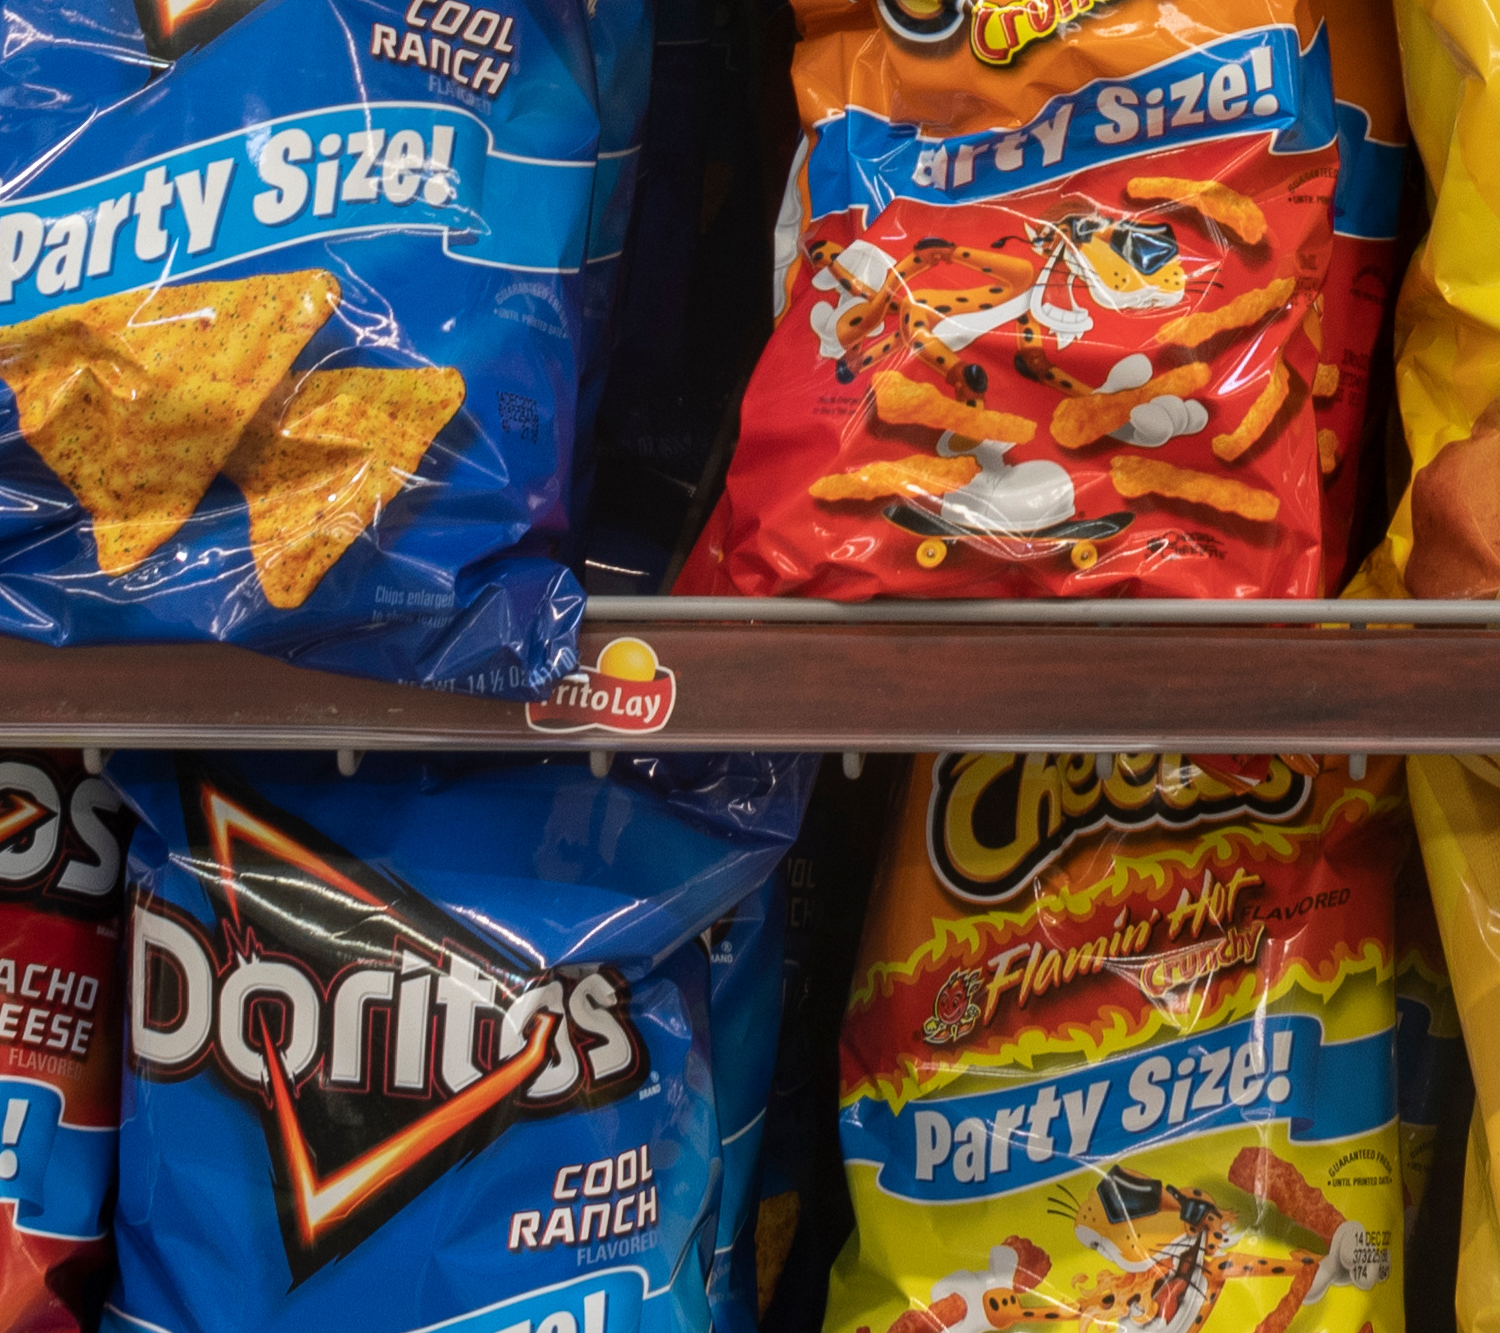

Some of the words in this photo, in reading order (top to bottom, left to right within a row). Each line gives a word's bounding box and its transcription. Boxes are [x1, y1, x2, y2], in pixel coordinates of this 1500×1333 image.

[373, 24, 513, 97] RANCH
[1095, 47, 1279, 144] Size!
[375, 585, 404, 605] Chips
[407, 587, 455, 607] enlarged
[133, 904, 632, 1098] Doritos
[915, 1082, 1111, 1183] Party
[1122, 1032, 1293, 1133] Size!
[553, 1144, 652, 1200] COOL
[1329, 1149, 1375, 1177] GUARANTEED
[1375, 1152, 1393, 1175] FRESH
[1332, 1177, 1351, 1188] UNTIL
[1353, 1176, 1377, 1187] PRINTED
[509, 1187, 657, 1250] RANCH
[576, 1230, 658, 1267] FLAVORED
